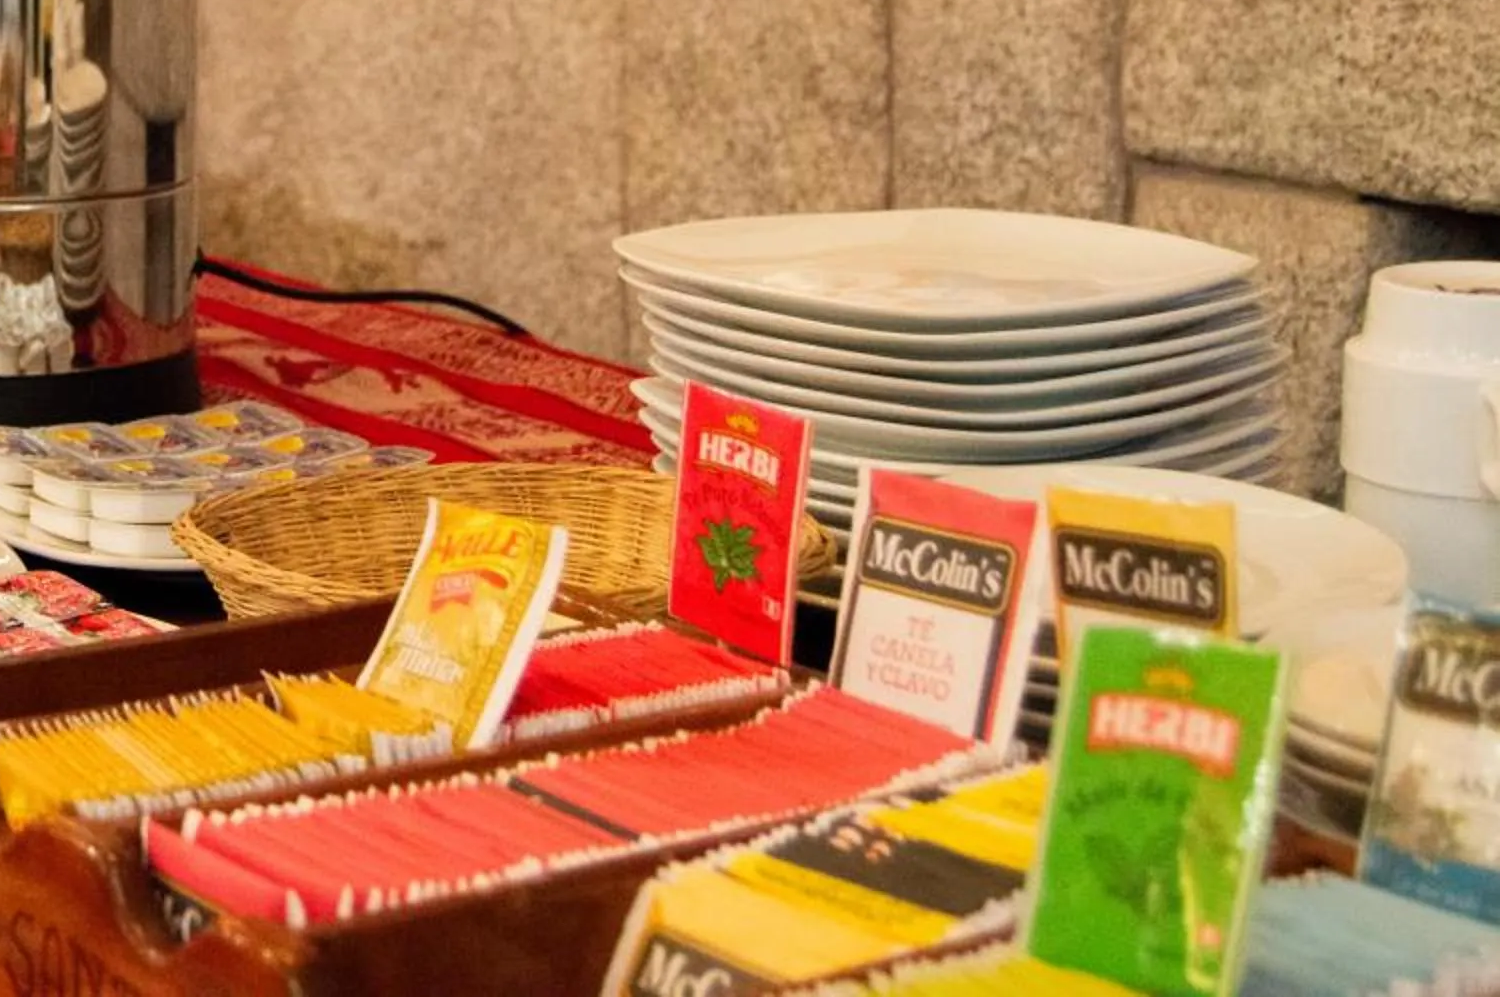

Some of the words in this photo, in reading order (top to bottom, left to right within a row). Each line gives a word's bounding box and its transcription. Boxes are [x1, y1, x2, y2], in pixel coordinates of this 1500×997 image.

[699, 431, 781, 487] HERBI
[866, 529, 1003, 599] McColin's
[1063, 542, 1215, 609] McColin's
[871, 634, 955, 675] CANELA
[1093, 694, 1234, 764] HERBI
